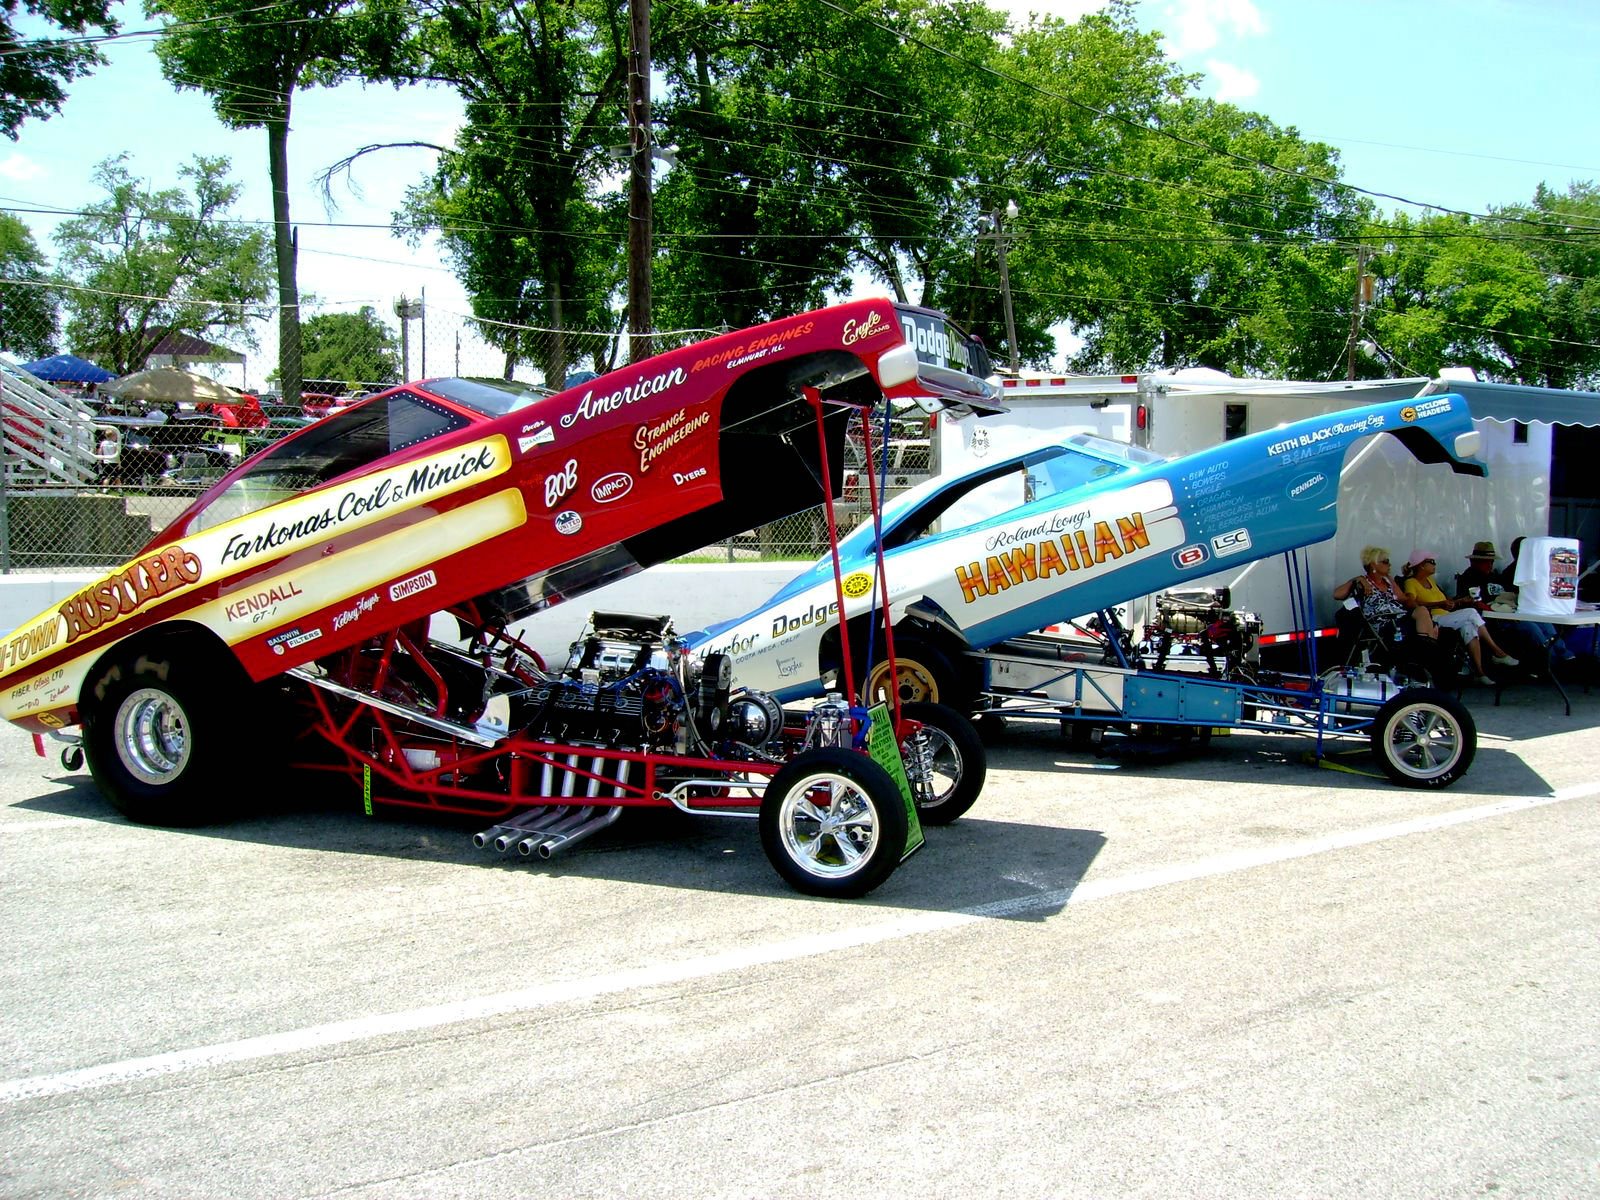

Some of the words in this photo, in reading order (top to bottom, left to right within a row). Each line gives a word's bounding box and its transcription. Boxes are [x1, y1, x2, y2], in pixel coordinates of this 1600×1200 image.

[842, 311, 881, 345] Engle
[868, 324, 890, 335] CAMS
[691, 345, 745, 373] RACING
[747, 321, 814, 353] ENGINES
[902, 316, 950, 368] Dodge
[559, 366, 688, 428] American
[1415, 398, 1449, 411] CYCLONE
[1417, 405, 1452, 418] HEADERS
[1267, 438, 1299, 456] KEITH
[1300, 429, 1333, 446] BLACK
[1332, 420, 1369, 435] Racing
[1206, 461, 1229, 475] AUTO
[336, 479, 393, 521] Coil
[404, 446, 495, 498] Minick
[595, 476, 628, 499] IMPACT
[1192, 472, 1226, 490] BOWERS
[1195, 482, 1222, 498] ENGLE
[1291, 473, 1325, 498] PENNZOIL
[1255, 495, 1271, 508] LTD
[559, 518, 581, 531] UNITED
[985, 523, 1047, 551] Roland
[1214, 531, 1247, 550] LSC
[954, 511, 1151, 604] HAWAIIAN
[58, 545, 202, 644] HUSTLER
[392, 573, 433, 599] SIMPSON
[225, 581, 303, 622] KENDALL
[772, 601, 839, 639] Dodge
[267, 628, 301, 647] BALDWIN
[288, 630, 321, 647] FILTERS
[735, 652, 756, 664] COSTA
[11, 684, 31, 701] FIBER
[51, 668, 64, 682] LTD
